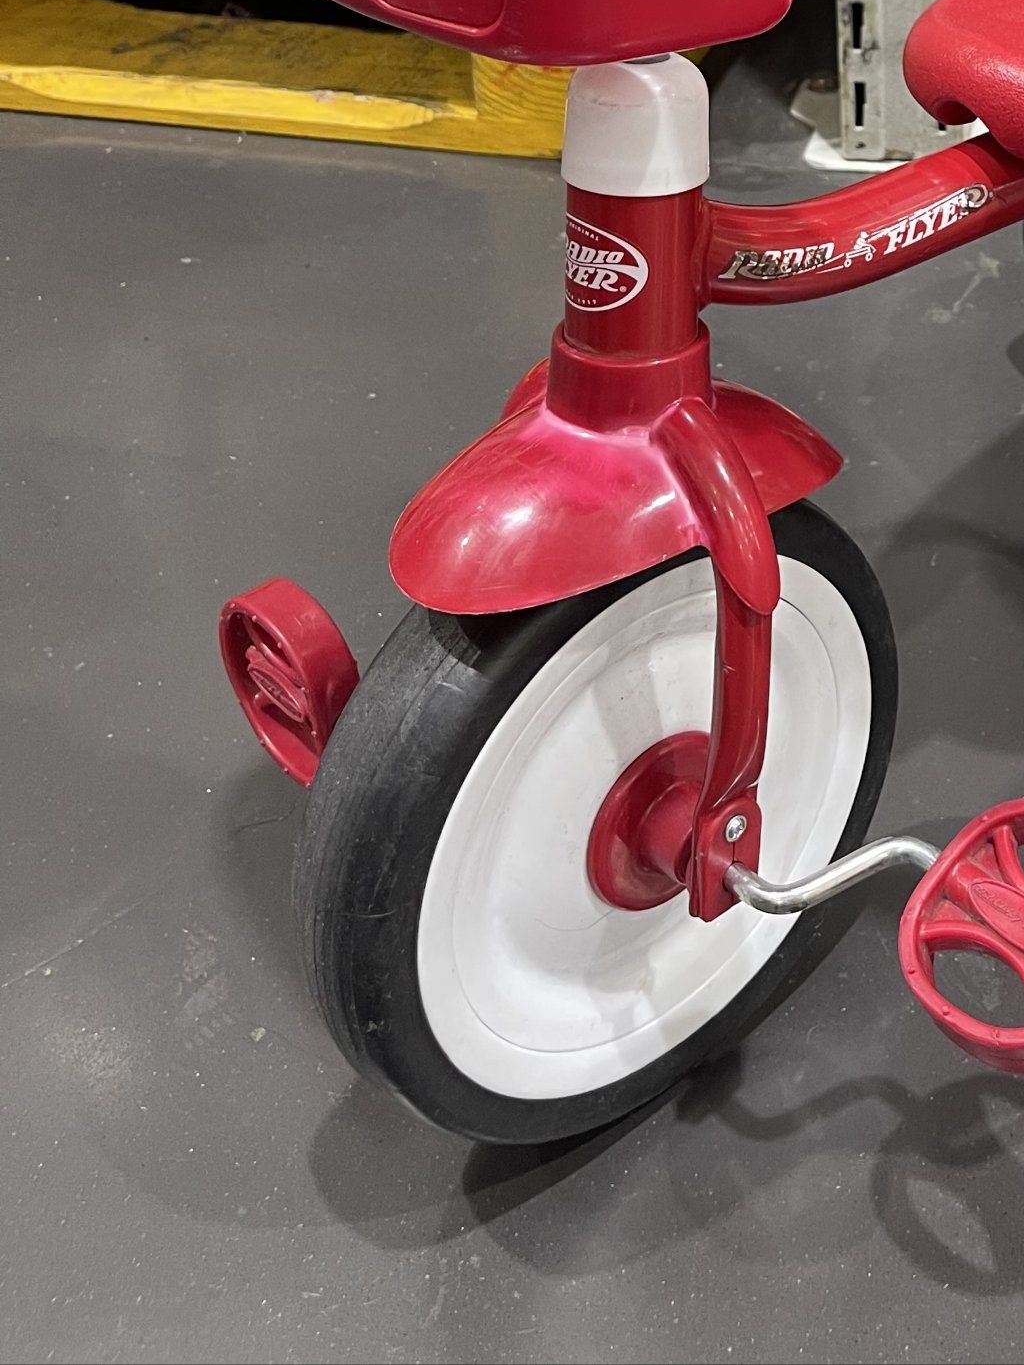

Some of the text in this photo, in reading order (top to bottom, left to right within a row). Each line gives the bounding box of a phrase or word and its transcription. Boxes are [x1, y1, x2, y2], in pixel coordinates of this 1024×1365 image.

[718, 184, 990, 280] RADIO FLYER
[566, 240, 625, 264] ADIO
[566, 260, 619, 292] YER
